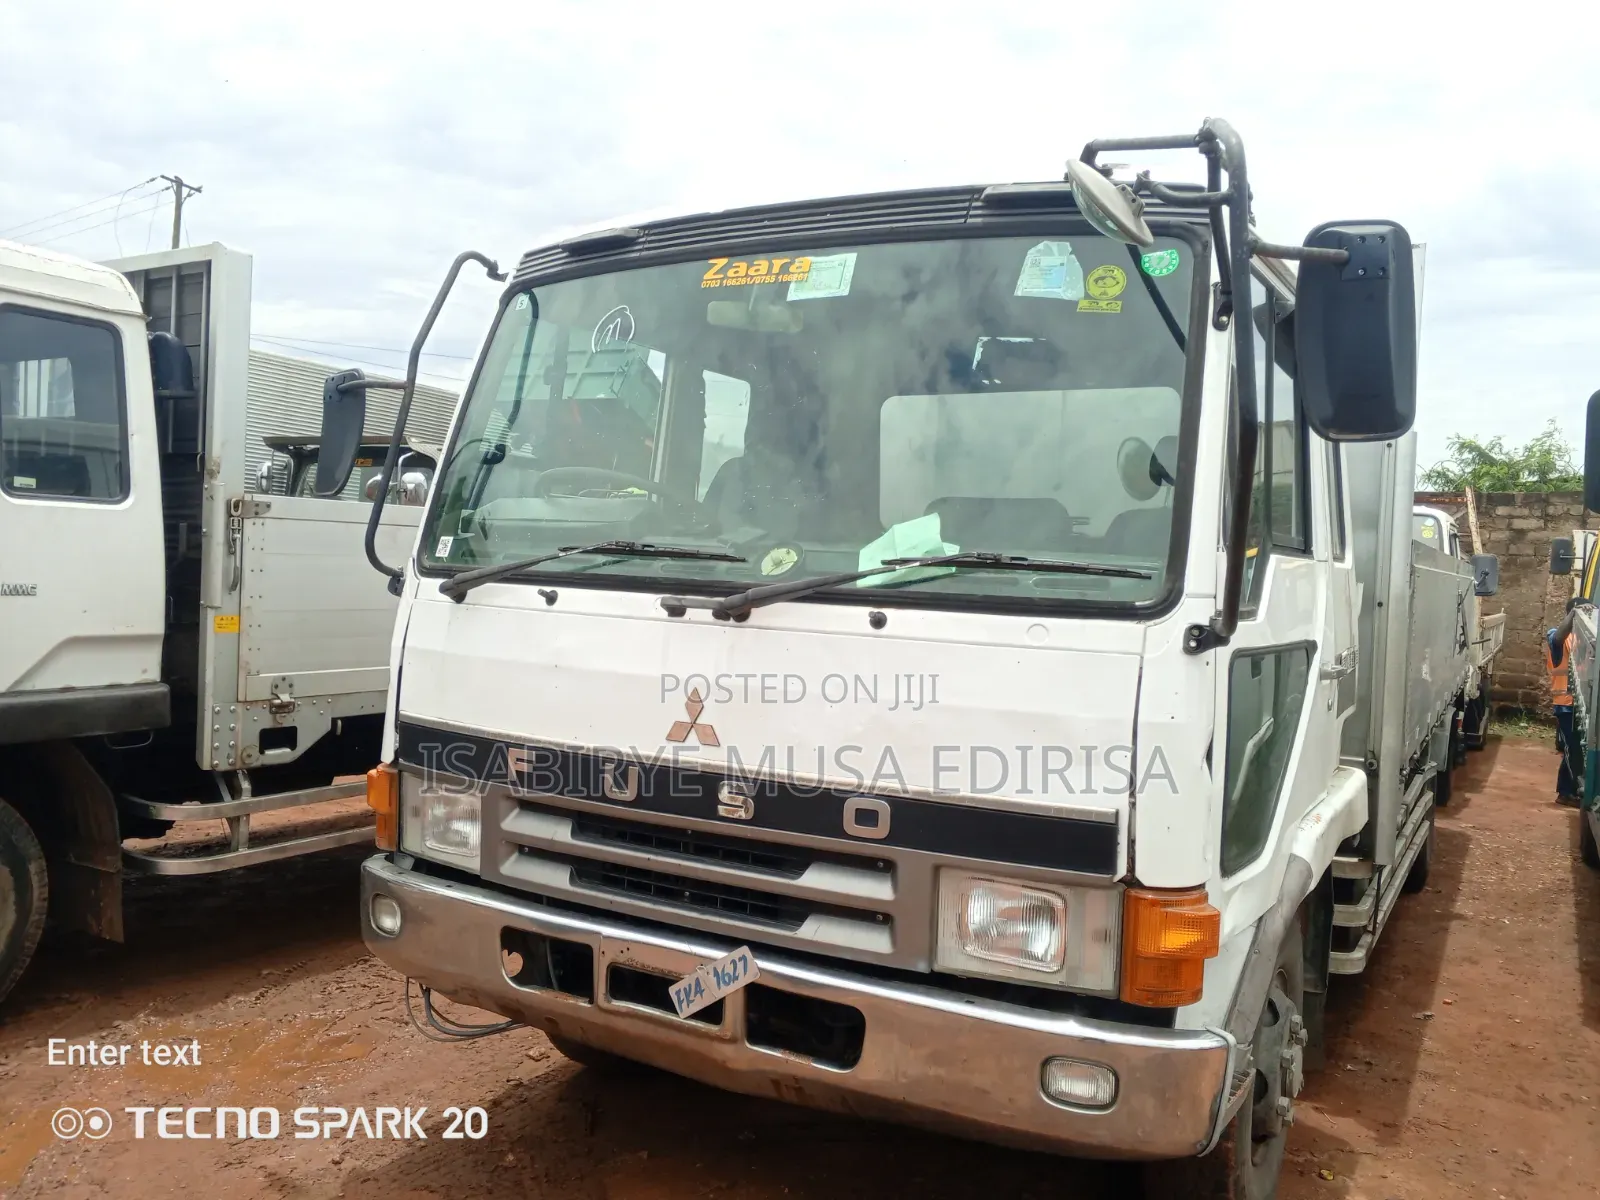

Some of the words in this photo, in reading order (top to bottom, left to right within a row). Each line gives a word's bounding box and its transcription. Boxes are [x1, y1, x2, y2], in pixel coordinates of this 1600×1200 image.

[703, 256, 812, 280] Zaara
[701, 280, 720, 289] 0703
[507, 747, 891, 840] FUSO
